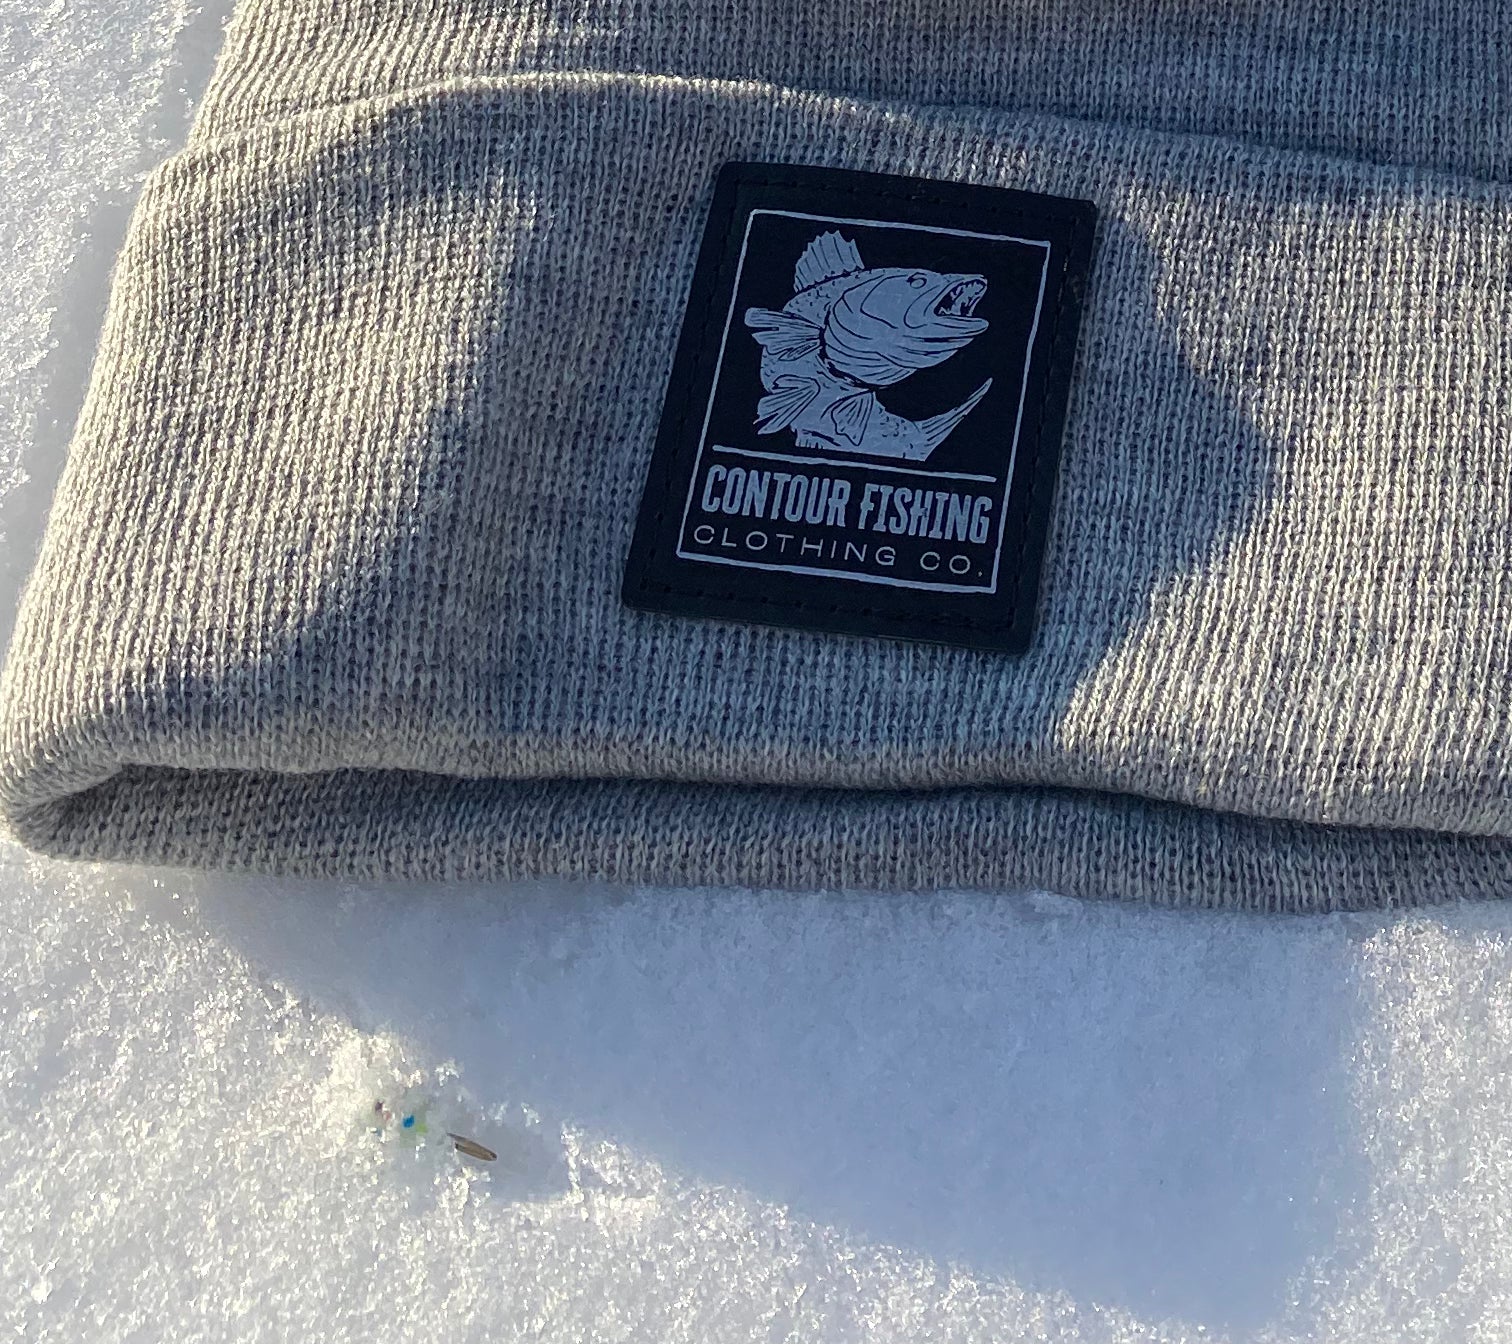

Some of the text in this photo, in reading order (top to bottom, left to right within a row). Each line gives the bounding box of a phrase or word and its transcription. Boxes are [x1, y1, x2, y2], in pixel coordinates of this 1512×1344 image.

[701, 464, 993, 544] CONTOUR FISHING
[693, 525, 896, 567] CLOTHING
